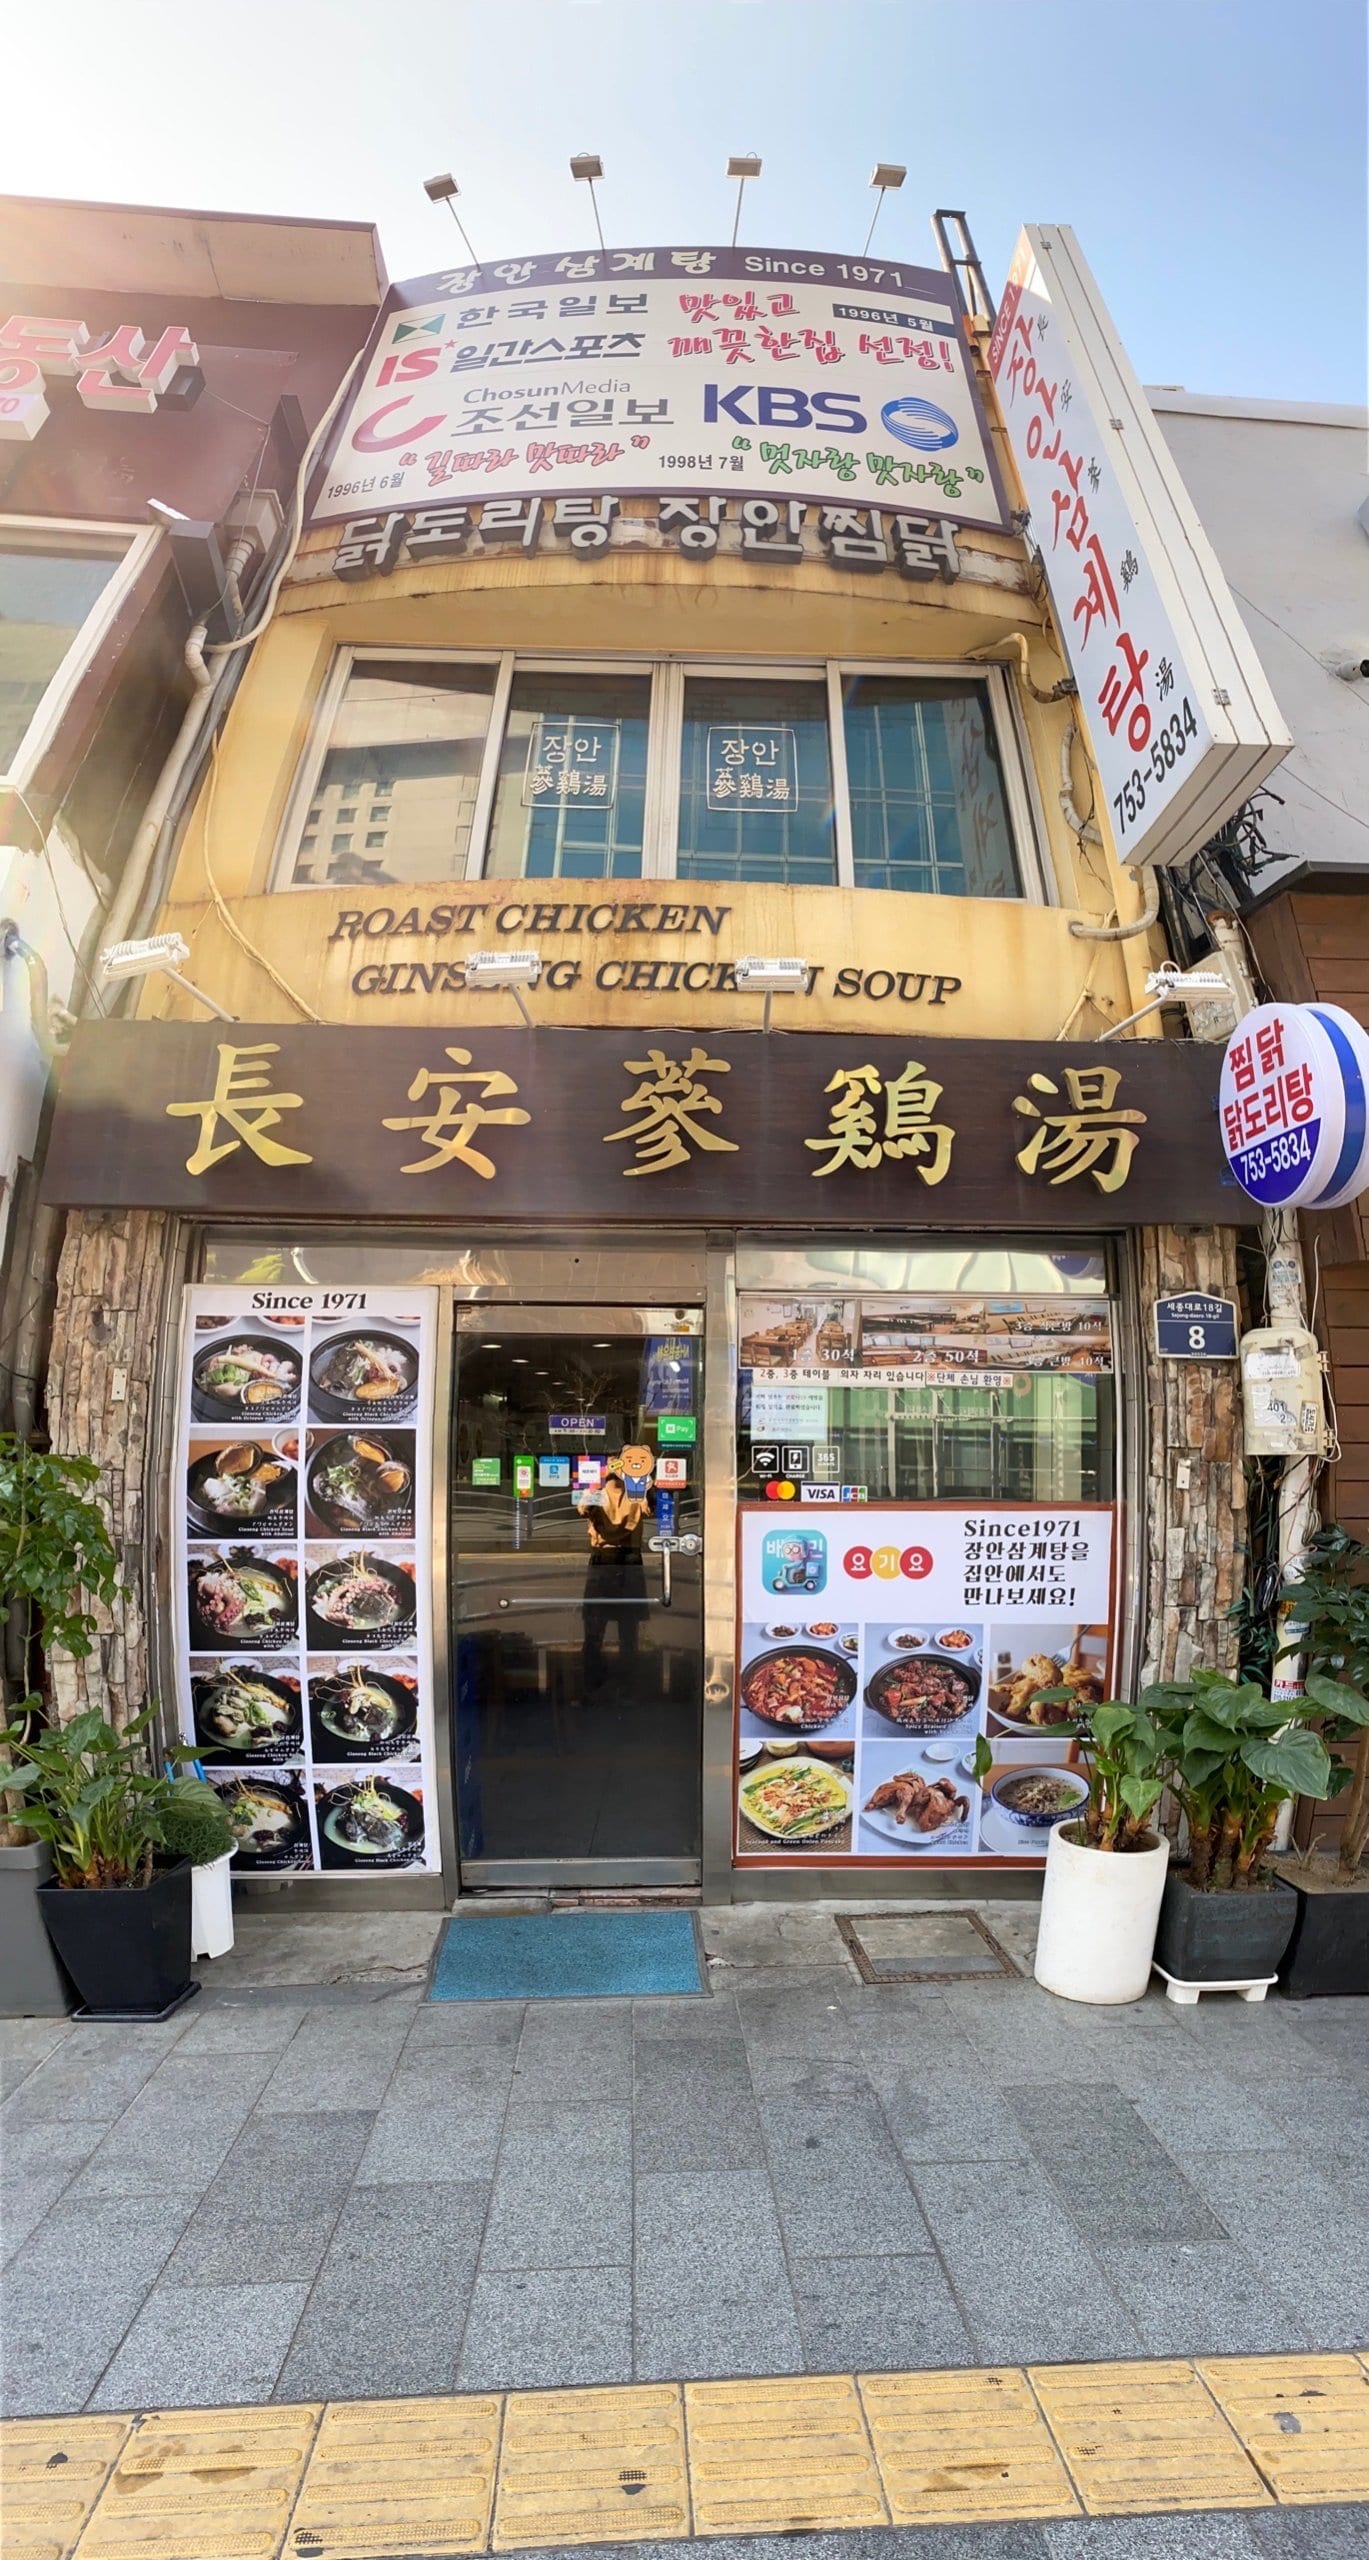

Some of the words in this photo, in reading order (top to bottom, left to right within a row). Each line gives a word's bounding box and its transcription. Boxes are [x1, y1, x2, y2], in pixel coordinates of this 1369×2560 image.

[436, 251, 716, 294] 장안삼계탕
[744, 256, 826, 277] Since
[837, 263, 903, 287] 1971
[456, 293, 649, 329] 한국일보
[679, 291, 799, 323] 맛있고
[838, 306, 899, 326] 1996년
[907, 316, 934, 332] 5월
[991, 304, 1012, 363] SINCE
[450, 333, 646, 373] 일간스포츠
[667, 325, 845, 365] 깨끗한집
[859, 334, 954, 372] 선정!
[451, 399, 674, 437] 조선일보
[703, 384, 868, 434] KBS
[658, 454, 713, 470] 1998년
[719, 455, 744, 471] 7월
[327, 477, 378, 499] 1996년
[380, 472, 405, 489] 6월
[331, 496, 621, 578] 닭도리탕
[658, 495, 963, 582] 장안찜닭
[542, 735, 602, 764] 장안
[721, 738, 780, 767] 장안
[1113, 696, 1199, 837] 753-5834
[328, 904, 489, 942] ROAST
[495, 903, 734, 937] CHICKEN
[352, 961, 582, 996] GINSG
[596, 960, 824, 997] CHICK
[833, 967, 963, 1005] SOUP
[1223, 1062, 1315, 1152] 닭도리탕
[1239, 1126, 1313, 1185] 753-5834
[251, 1293, 313, 1310] Since
[322, 1293, 367, 1310] 1971
[1167, 1302, 1222, 1313] 세종대로18길
[1078, 1321, 1102, 1332] 10석
[1189, 1325, 1206, 1350] 8
[821, 1349, 855, 1362] 30석
[912, 1350, 937, 1363] 2층
[944, 1349, 979, 1363] 50석
[1080, 1355, 1104, 1367] 10석
[783, 1369, 798, 1380] 3층
[802, 1369, 831, 1379] 테이블
[840, 1369, 858, 1380] 의자
[863, 1369, 882, 1380] 자리
[886, 1369, 924, 1382] 있습니다
[960, 1373, 978, 1385] 손님
[561, 1418, 594, 1427] OPEN
[817, 1453, 835, 1462] 365
[808, 1488, 835, 1499] VISA
[851, 1552, 925, 1572] 요기요
[964, 1541, 1089, 1561] 장안삼계탕을
[964, 1564, 1066, 1583] 집안에서도
[964, 1587, 1076, 1606] 만나보세요!
